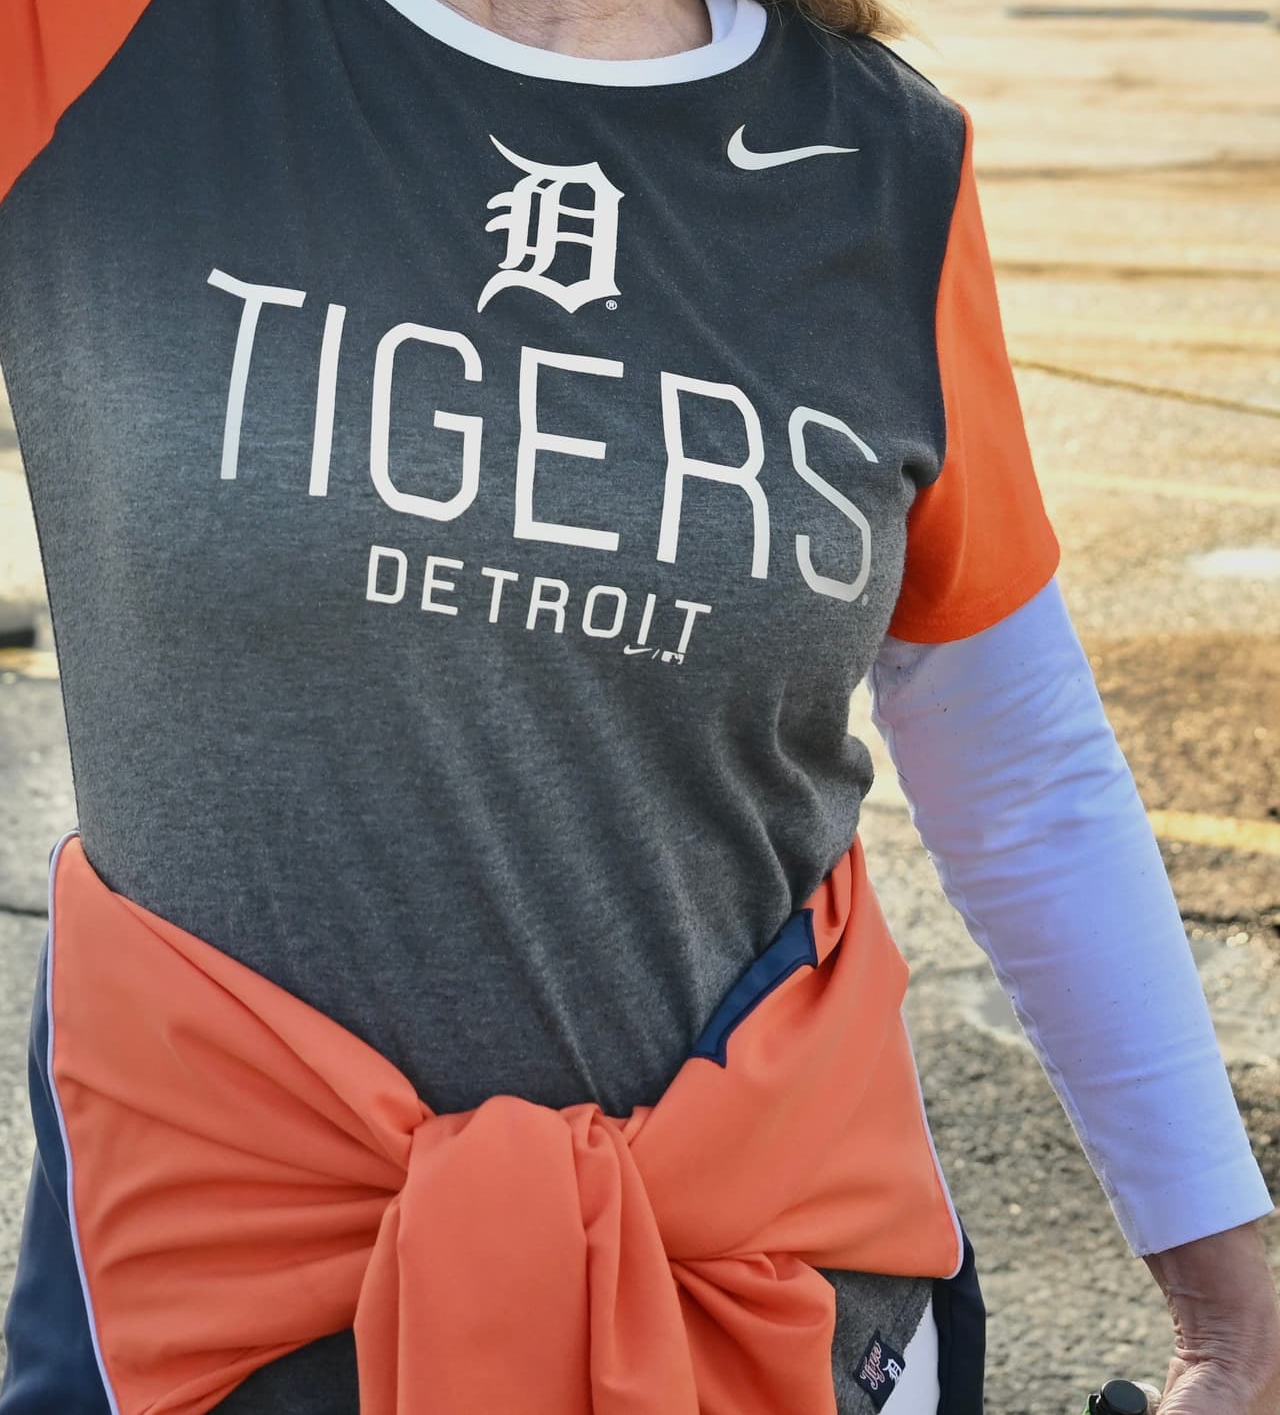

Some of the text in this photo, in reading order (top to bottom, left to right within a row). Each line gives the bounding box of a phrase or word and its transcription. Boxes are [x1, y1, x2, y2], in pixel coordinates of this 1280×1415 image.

[477, 133, 625, 314] D
[206, 268, 880, 604] TIGERS
[365, 545, 713, 654] DETROIT
